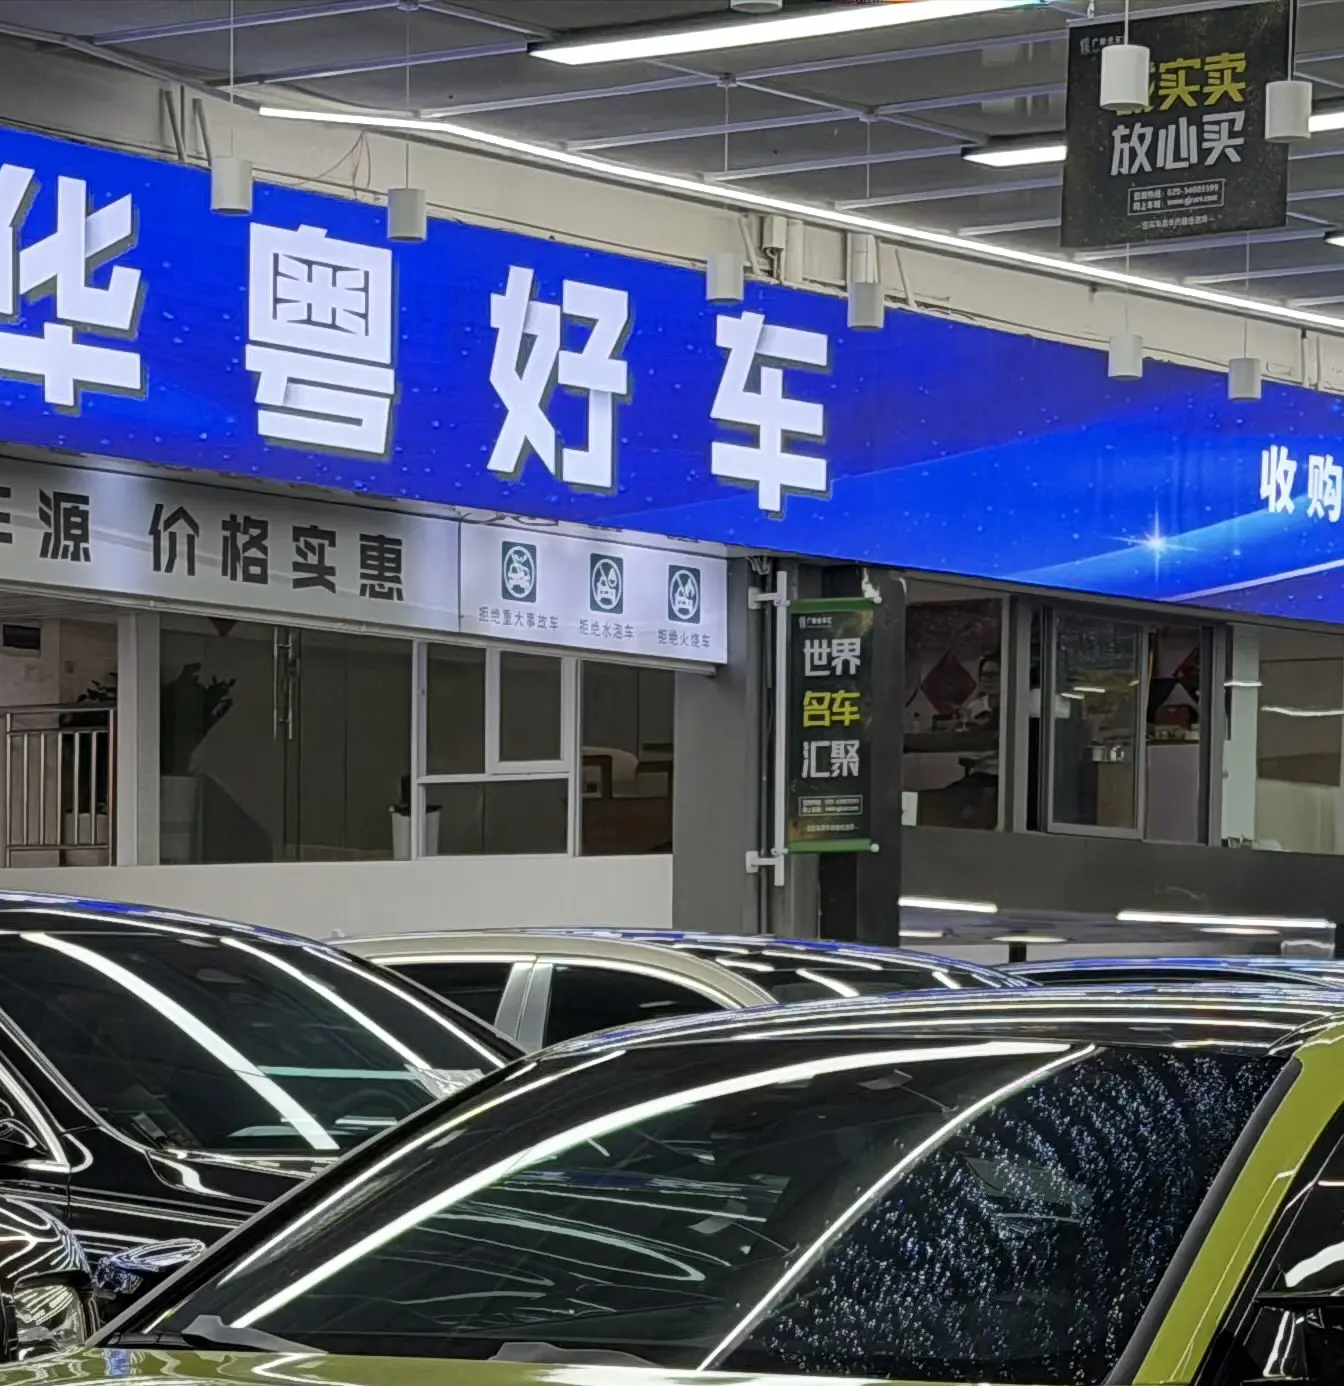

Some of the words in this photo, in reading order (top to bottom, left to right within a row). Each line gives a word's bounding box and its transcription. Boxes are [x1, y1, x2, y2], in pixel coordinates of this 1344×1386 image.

[1110, 110, 1245, 176] 放心买
[148, 504, 404, 601] 价格实惠
[479, 606, 559, 631] 拒绝重大事故车
[579, 619, 635, 640] 拒绝水泡车
[657, 629, 711, 649] 拒绝火烧车
[803, 637, 861, 677] 世界
[802, 689, 861, 728] 名车
[801, 739, 860, 779] 汇聚
